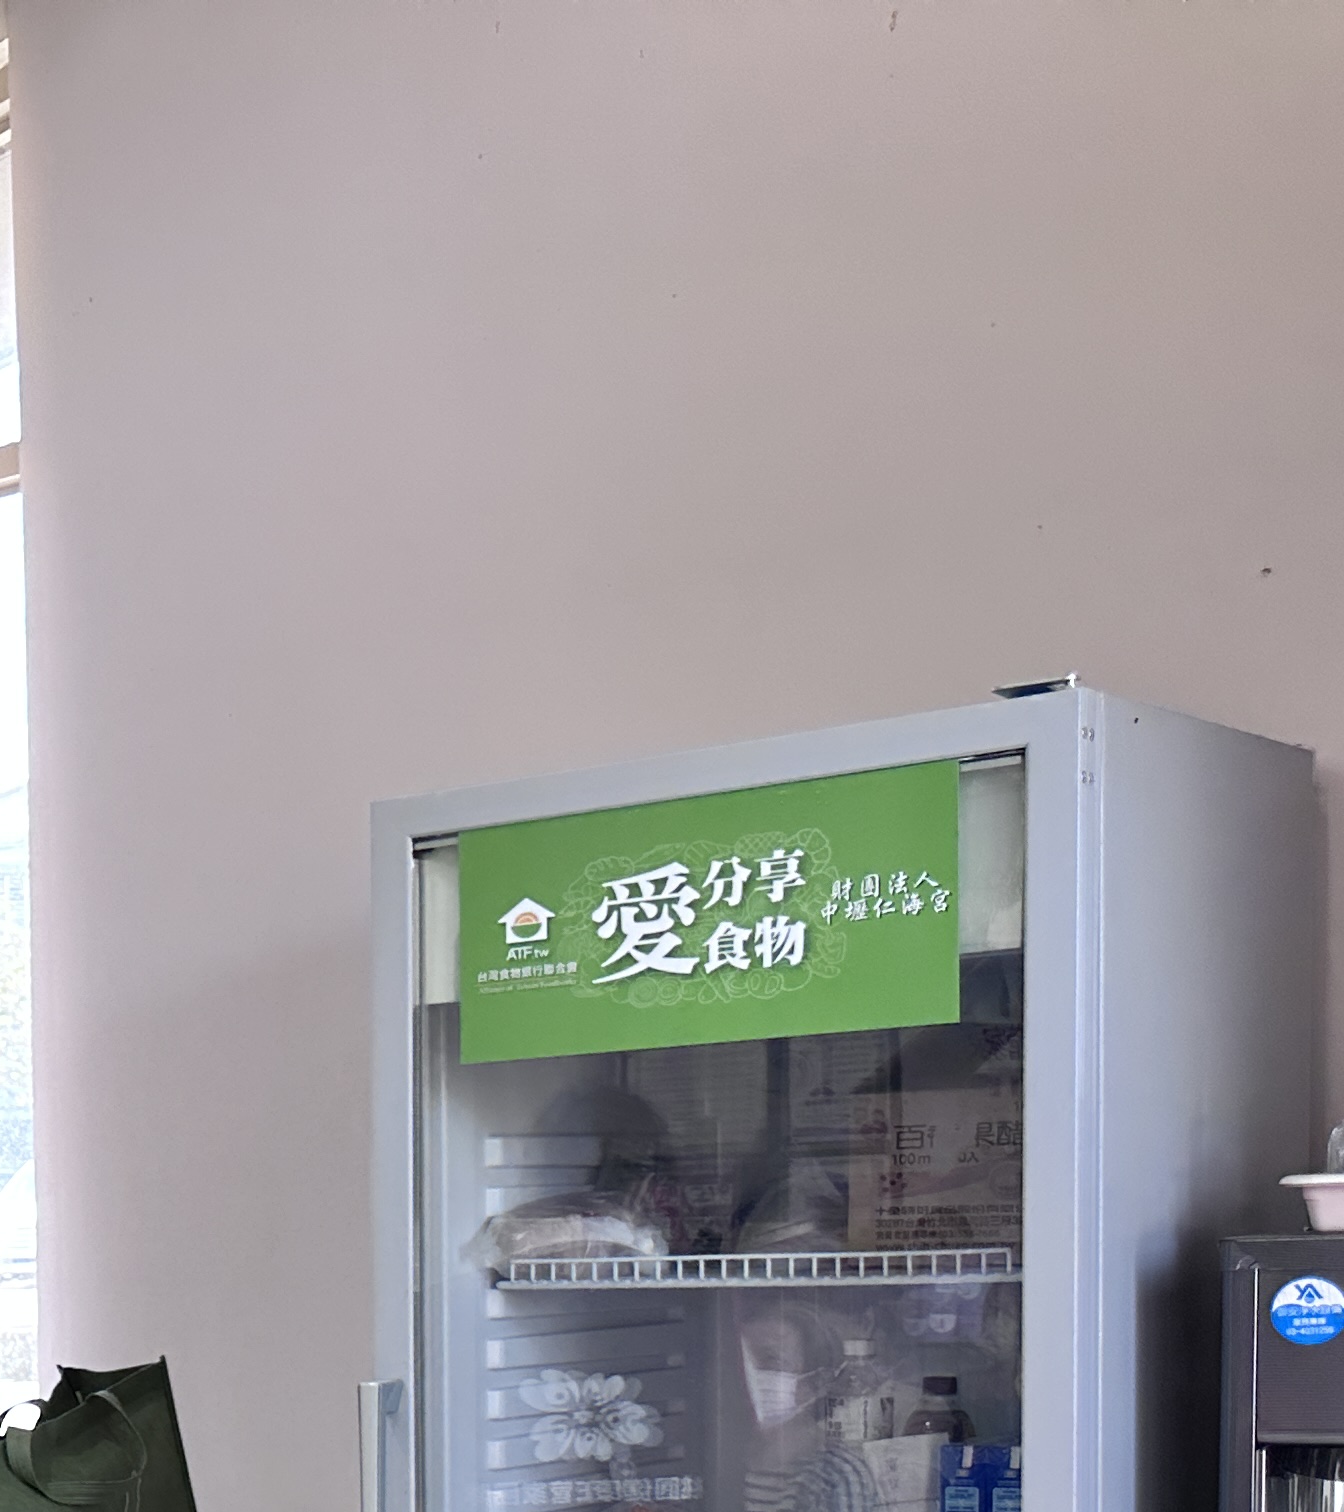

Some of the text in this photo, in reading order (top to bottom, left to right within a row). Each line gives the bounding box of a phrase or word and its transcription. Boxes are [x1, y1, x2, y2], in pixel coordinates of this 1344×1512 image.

[702, 848, 807, 911] 分享
[820, 888, 951, 926] 中壢仁海宮
[831, 871, 939, 901] 財團法人
[592, 861, 701, 985] 愛
[702, 916, 807, 975] 食物
